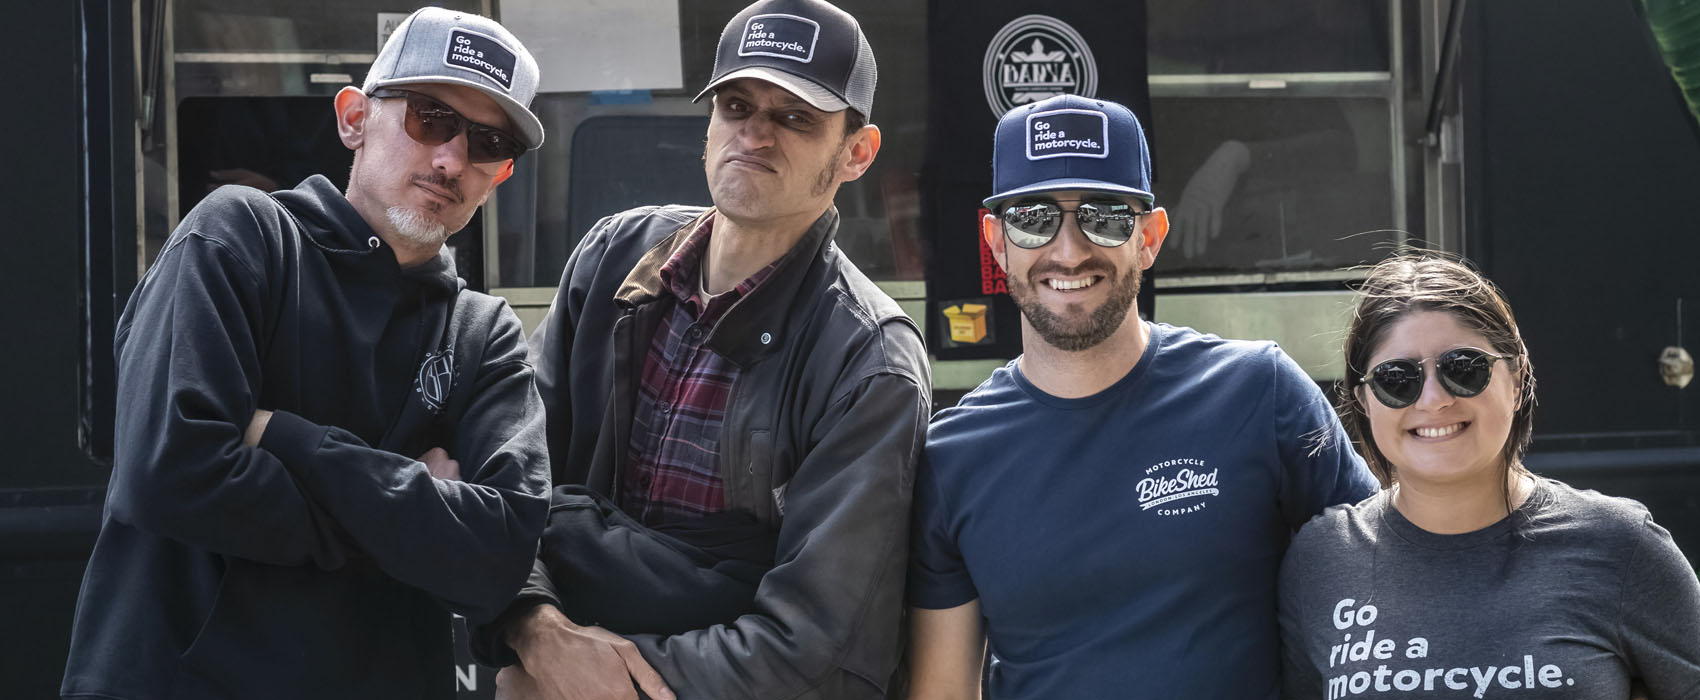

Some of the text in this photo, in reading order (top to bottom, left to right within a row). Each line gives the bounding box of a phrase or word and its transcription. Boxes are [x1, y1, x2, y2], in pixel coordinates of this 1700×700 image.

[751, 22, 764, 31] Go
[455, 35, 472, 46] Go
[748, 30, 767, 39] ride
[453, 44, 475, 57] ride
[745, 39, 806, 52] motorcycle.
[451, 53, 509, 83] motorcycle.
[1034, 121, 1050, 130] Go
[1034, 130, 1065, 141] ride a
[1034, 139, 1100, 150] motorcycle.
[982, 266, 1008, 280] BA
[983, 280, 1009, 295] BA
[1145, 458, 1205, 475] MOTORCYCLE
[1135, 467, 1219, 503] BikeShed
[1157, 501, 1207, 516] COMPANY
[1332, 598, 1378, 630] Go
[1329, 629, 1429, 668] ride a
[1328, 654, 1575, 700] motorcycle.
